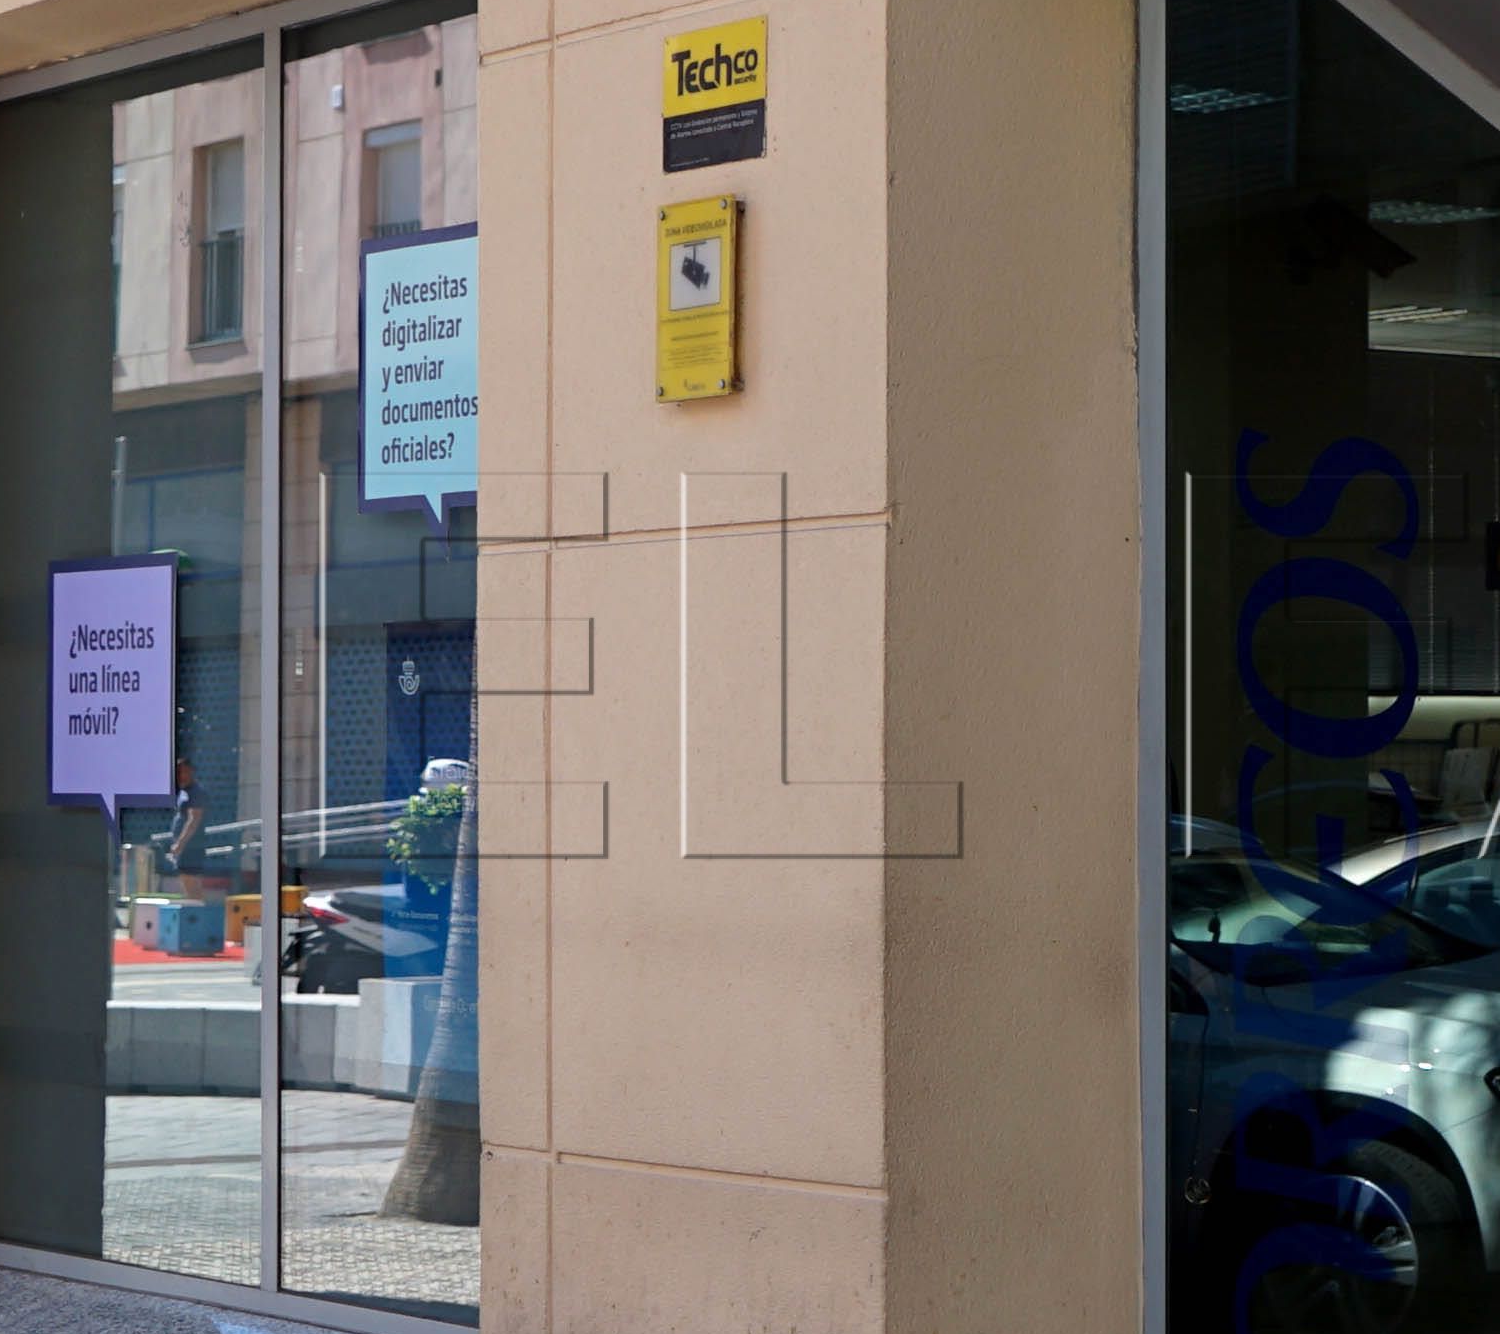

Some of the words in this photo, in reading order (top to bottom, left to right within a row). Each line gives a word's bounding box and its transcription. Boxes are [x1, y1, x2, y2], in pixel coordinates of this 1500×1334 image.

[671, 43, 758, 97] Techco
[382, 275, 468, 314] ¿Necesitas
[382, 315, 462, 352] digitalizar
[382, 365, 391, 392] y
[395, 357, 444, 383] enviar
[382, 394, 479, 425] documentos
[381, 432, 455, 465] oficiales?
[69, 621, 154, 659] ¿Necesitas
[69, 670, 97, 694] una
[101, 665, 140, 693] línea
[68, 706, 119, 735] móvil?
